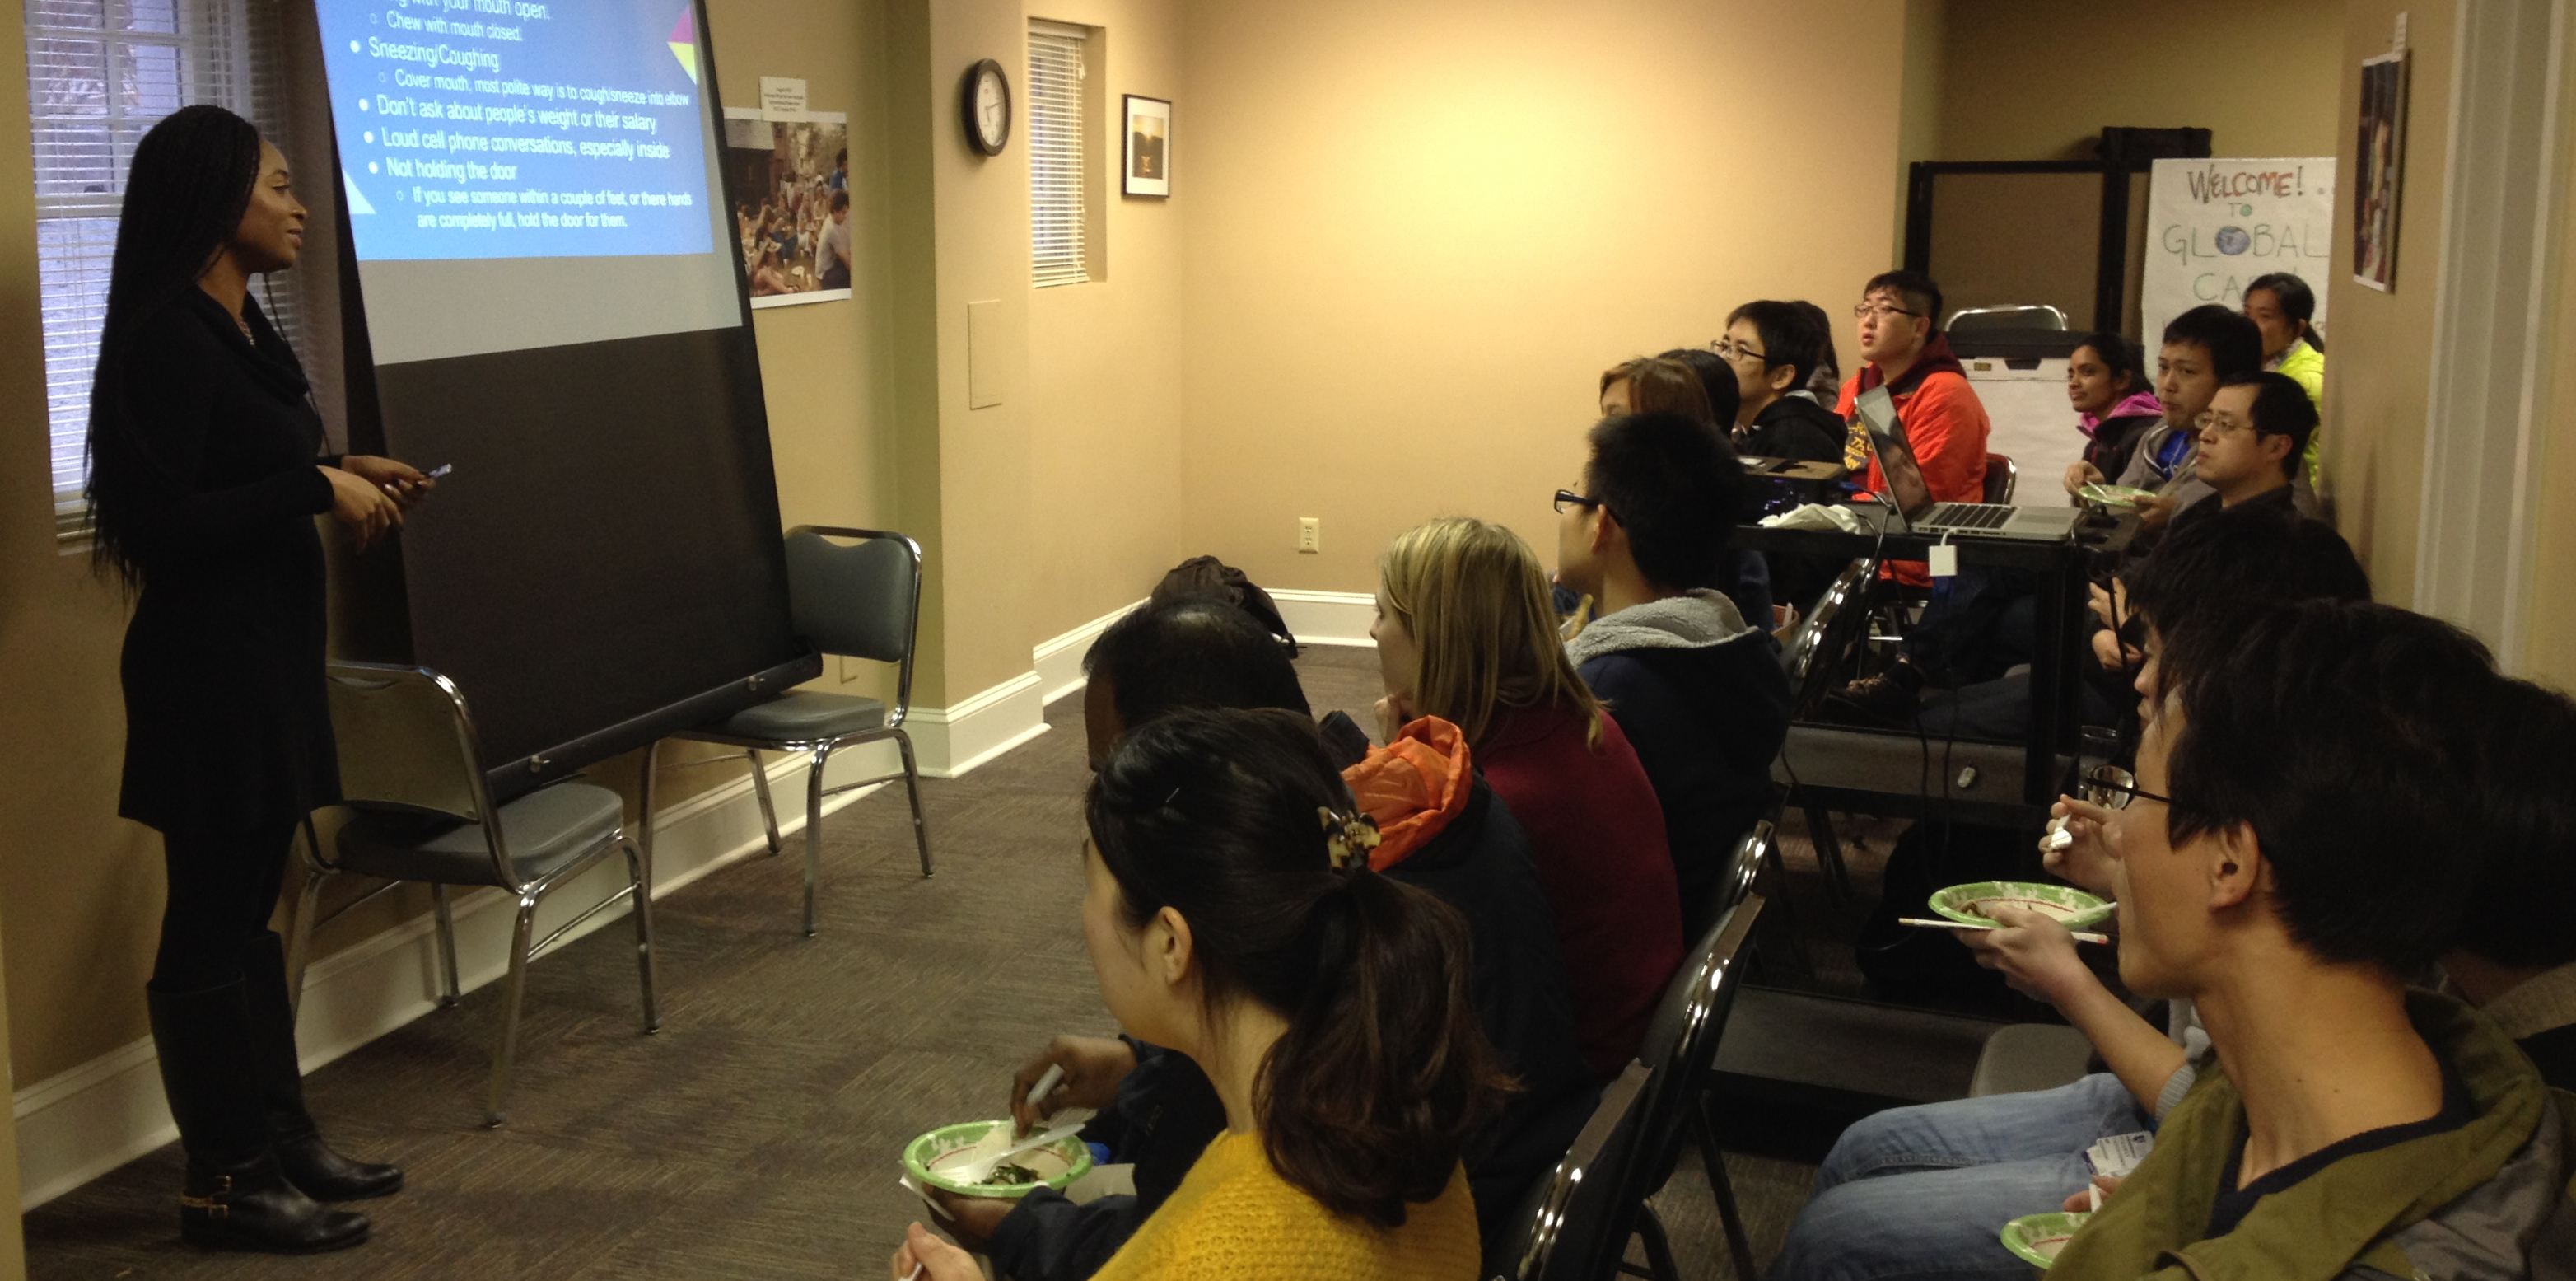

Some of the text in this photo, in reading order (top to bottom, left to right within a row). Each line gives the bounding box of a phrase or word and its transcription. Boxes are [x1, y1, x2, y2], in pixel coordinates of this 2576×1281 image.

[386, 10, 523, 41] Chew with mouth closed.
[474, 0, 511, 15] mouth
[515, 2, 551, 21] open.
[369, 36, 501, 72] Sneezing/Coughing
[394, 69, 430, 88] Cover
[434, 74, 472, 92] mouth,
[474, 78, 499, 94] most
[502, 79, 530, 97] polite
[532, 84, 553, 101] way
[556, 83, 565, 98] is
[567, 85, 577, 99] to
[648, 90, 664, 105] into
[665, 91, 689, 106] elbow
[376, 94, 656, 135] Don't ask about people's weight or their salary
[381, 127, 670, 161] Loud cell phone conversations, especially inside
[385, 157, 517, 184] Not holding the door
[2187, 164, 2303, 203] WELCOME!
[413, 186, 422, 203] If
[423, 190, 446, 207] you
[447, 190, 469, 203] see
[470, 190, 518, 204] someone
[519, 189, 548, 204] within
[551, 192, 558, 204] a
[560, 190, 594, 208] couple
[595, 189, 606, 205] of
[629, 194, 640, 206] or
[641, 191, 666, 206] there
[667, 191, 693, 206] hands
[2228, 202, 2252, 217] TO
[417, 214, 436, 227] are
[438, 212, 496, 231] completely
[517, 212, 540, 227] hold
[541, 212, 559, 227] the
[560, 213, 584, 227] door
[585, 212, 600, 227] for
[600, 213, 628, 227] them.
[2163, 223, 2330, 266] GLOBAL
